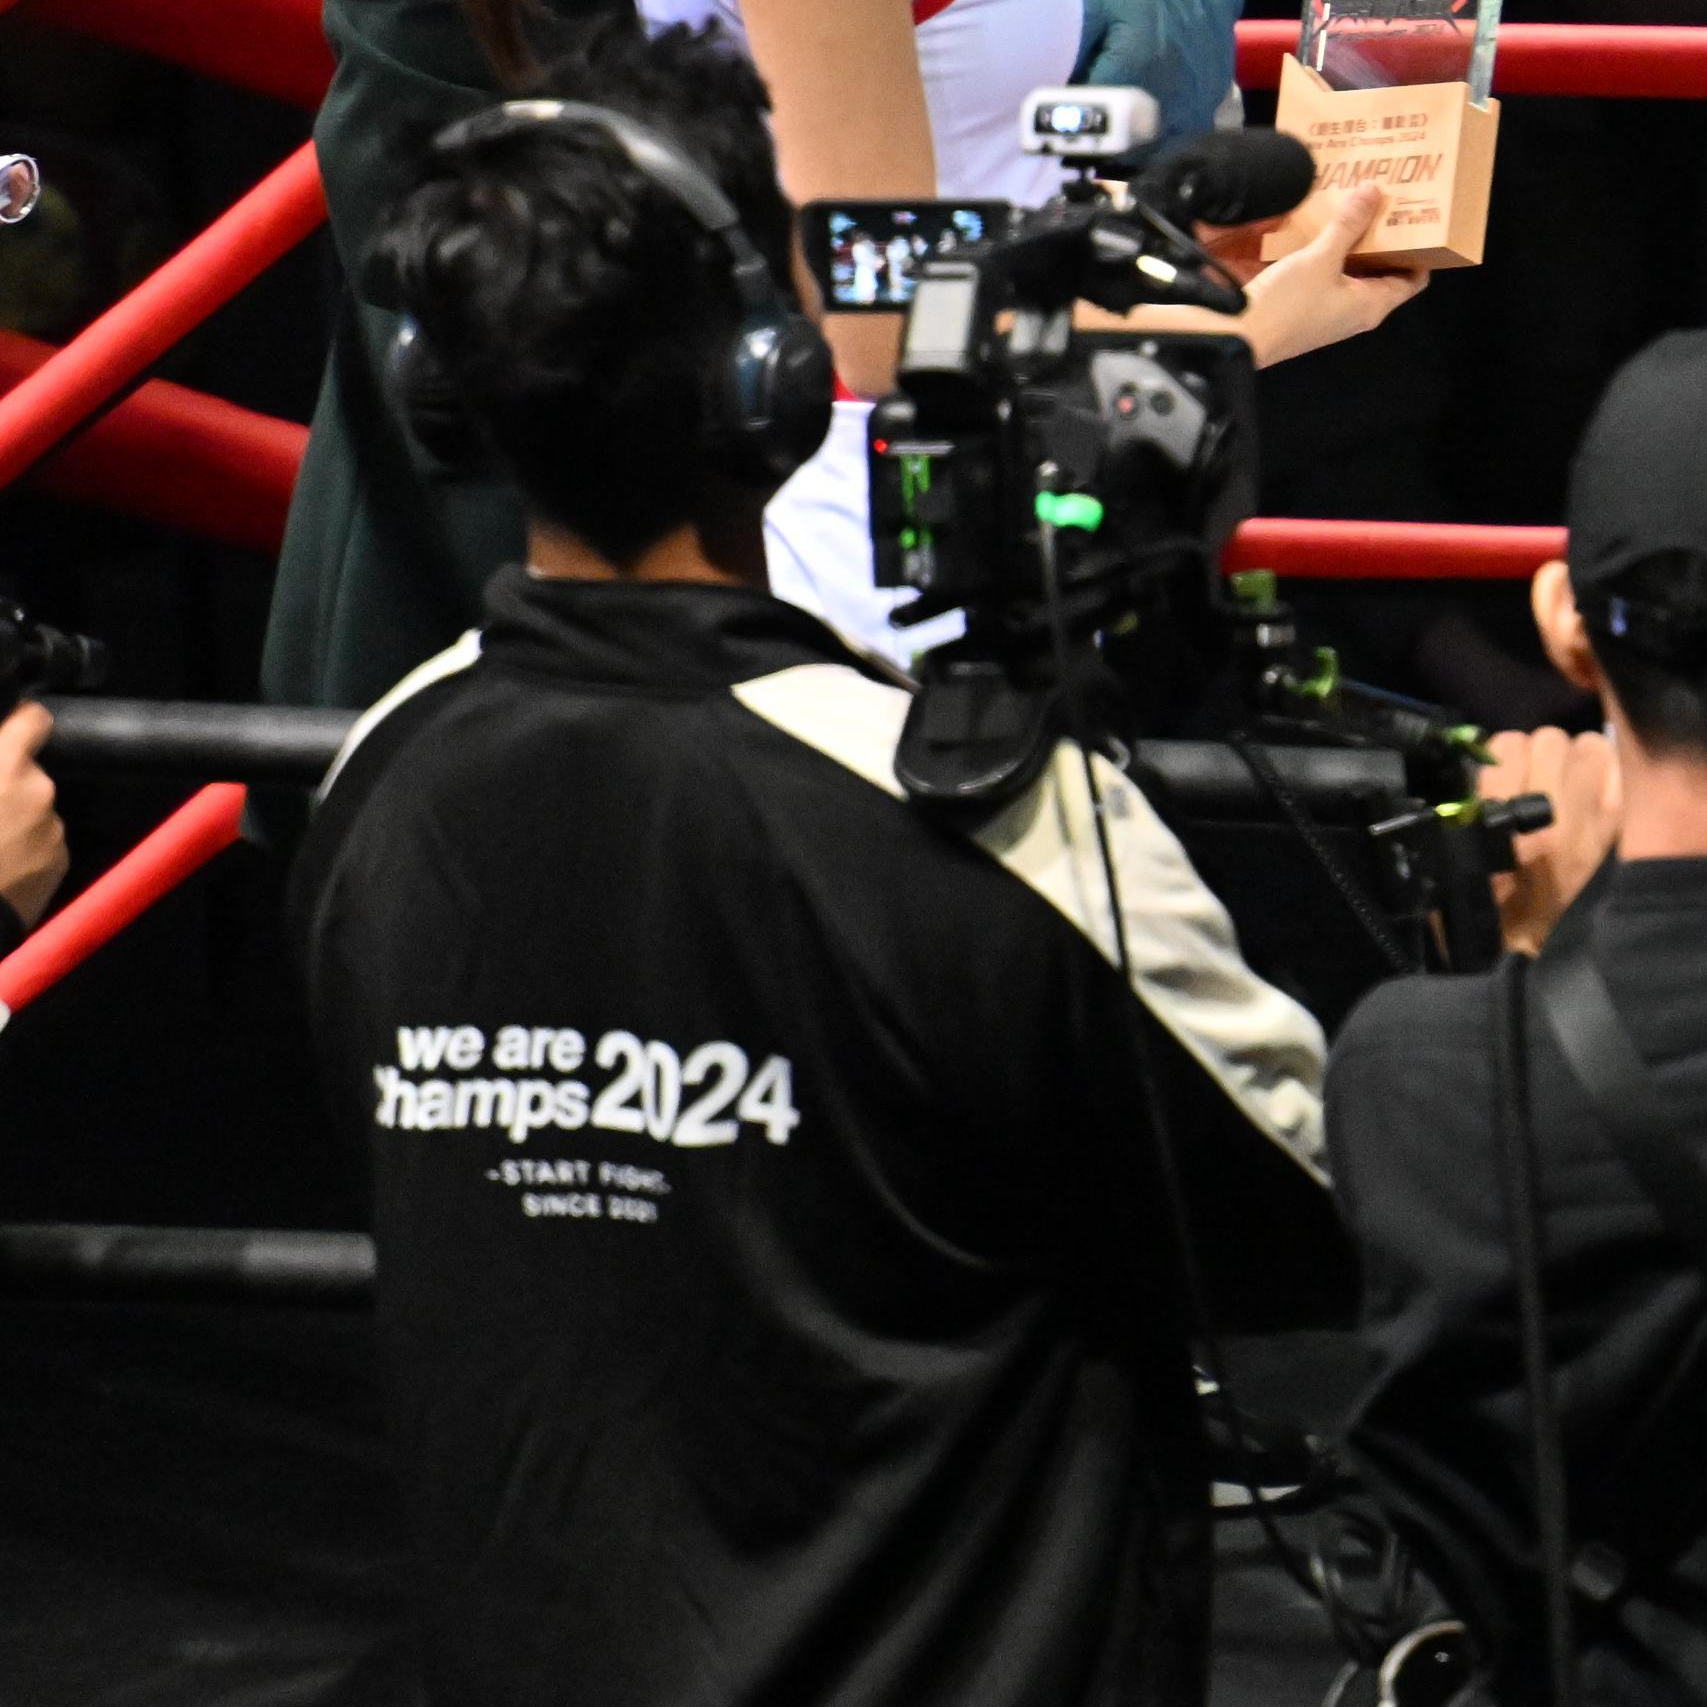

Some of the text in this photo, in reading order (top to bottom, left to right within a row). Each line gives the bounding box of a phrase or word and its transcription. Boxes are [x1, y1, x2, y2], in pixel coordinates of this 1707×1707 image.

[1314, 152, 1443, 191] HAMPION
[396, 1025, 586, 1071] we are
[590, 1030, 802, 1148] 2024
